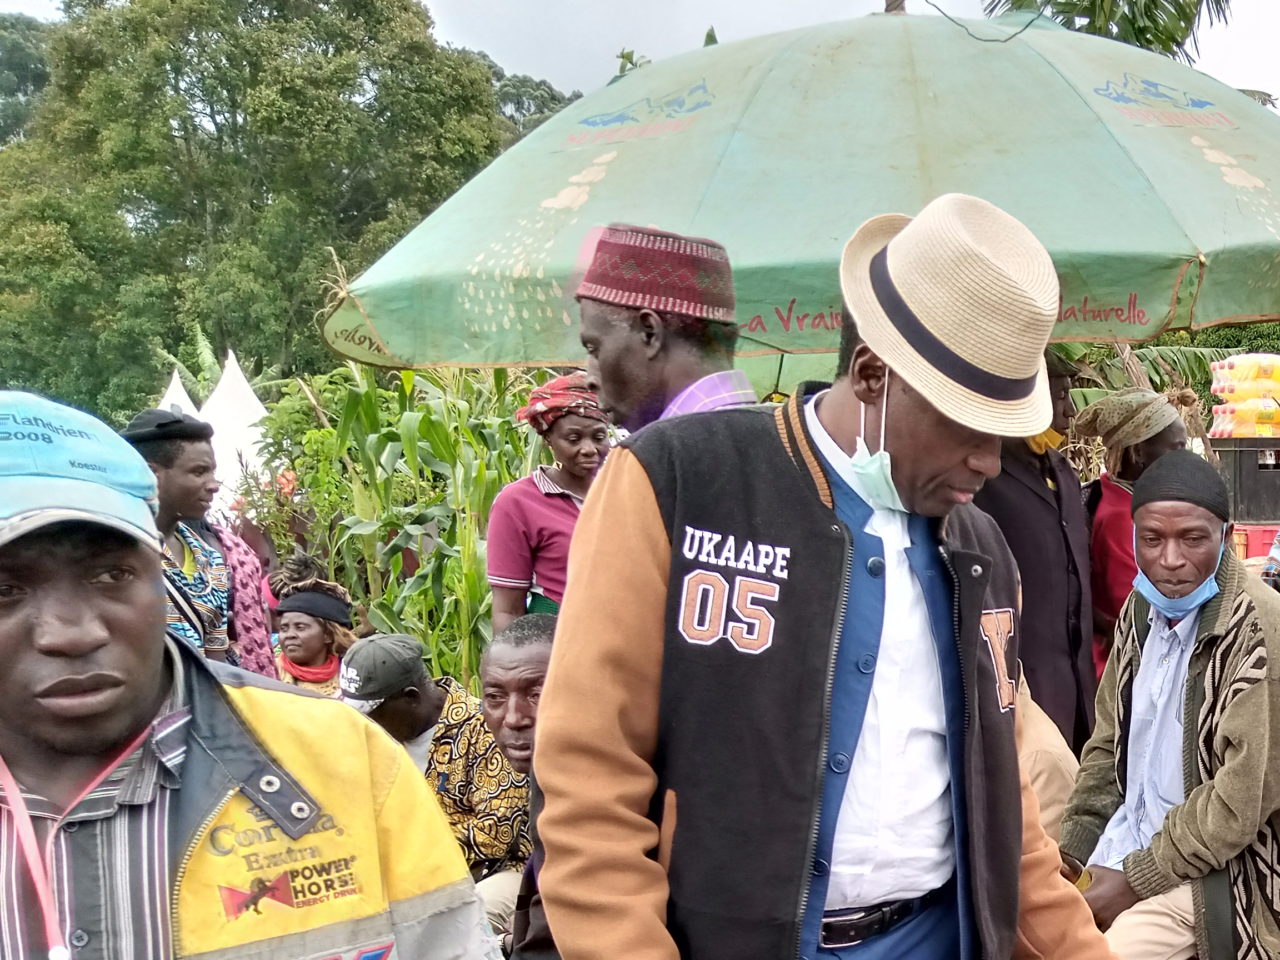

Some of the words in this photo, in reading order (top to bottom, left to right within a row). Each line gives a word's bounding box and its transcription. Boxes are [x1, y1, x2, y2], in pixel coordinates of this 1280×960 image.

[683, 525, 791, 580] UKAAPE
[678, 568, 780, 655] 05
[209, 812, 338, 857] Cora
